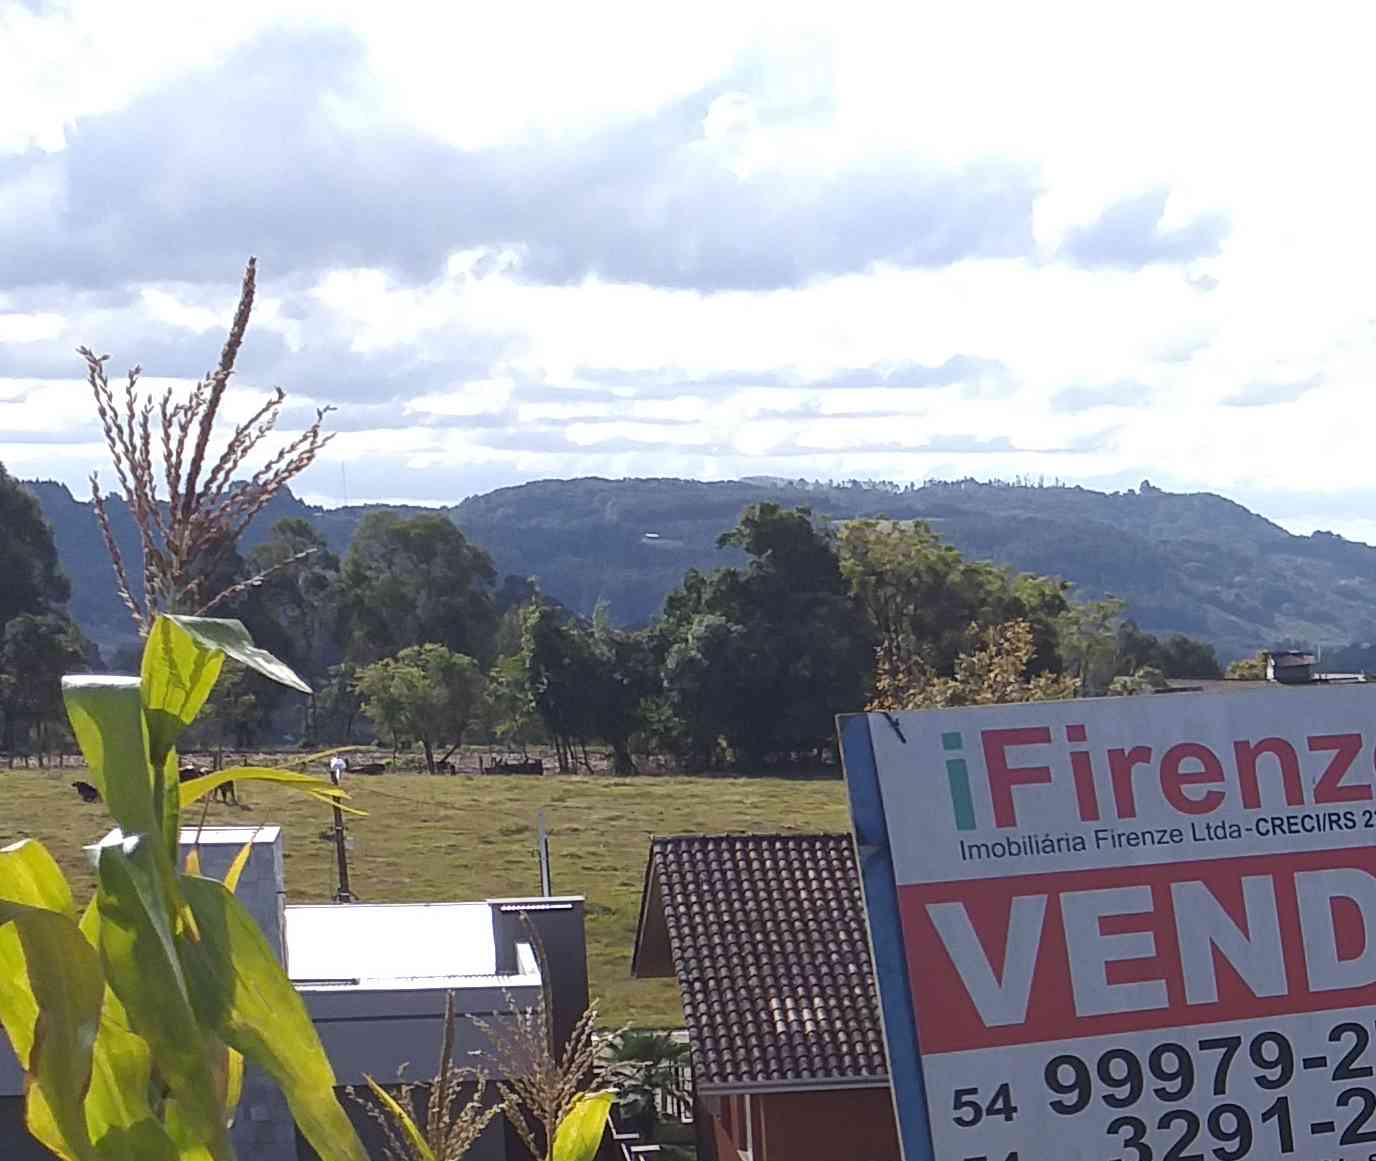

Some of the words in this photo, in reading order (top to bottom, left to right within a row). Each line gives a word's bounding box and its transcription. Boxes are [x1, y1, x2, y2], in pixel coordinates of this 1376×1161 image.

[959, 832, 1087, 861] Imobiliária
[1094, 821, 1184, 850] Firenze
[952, 1083, 1017, 1127] 54
